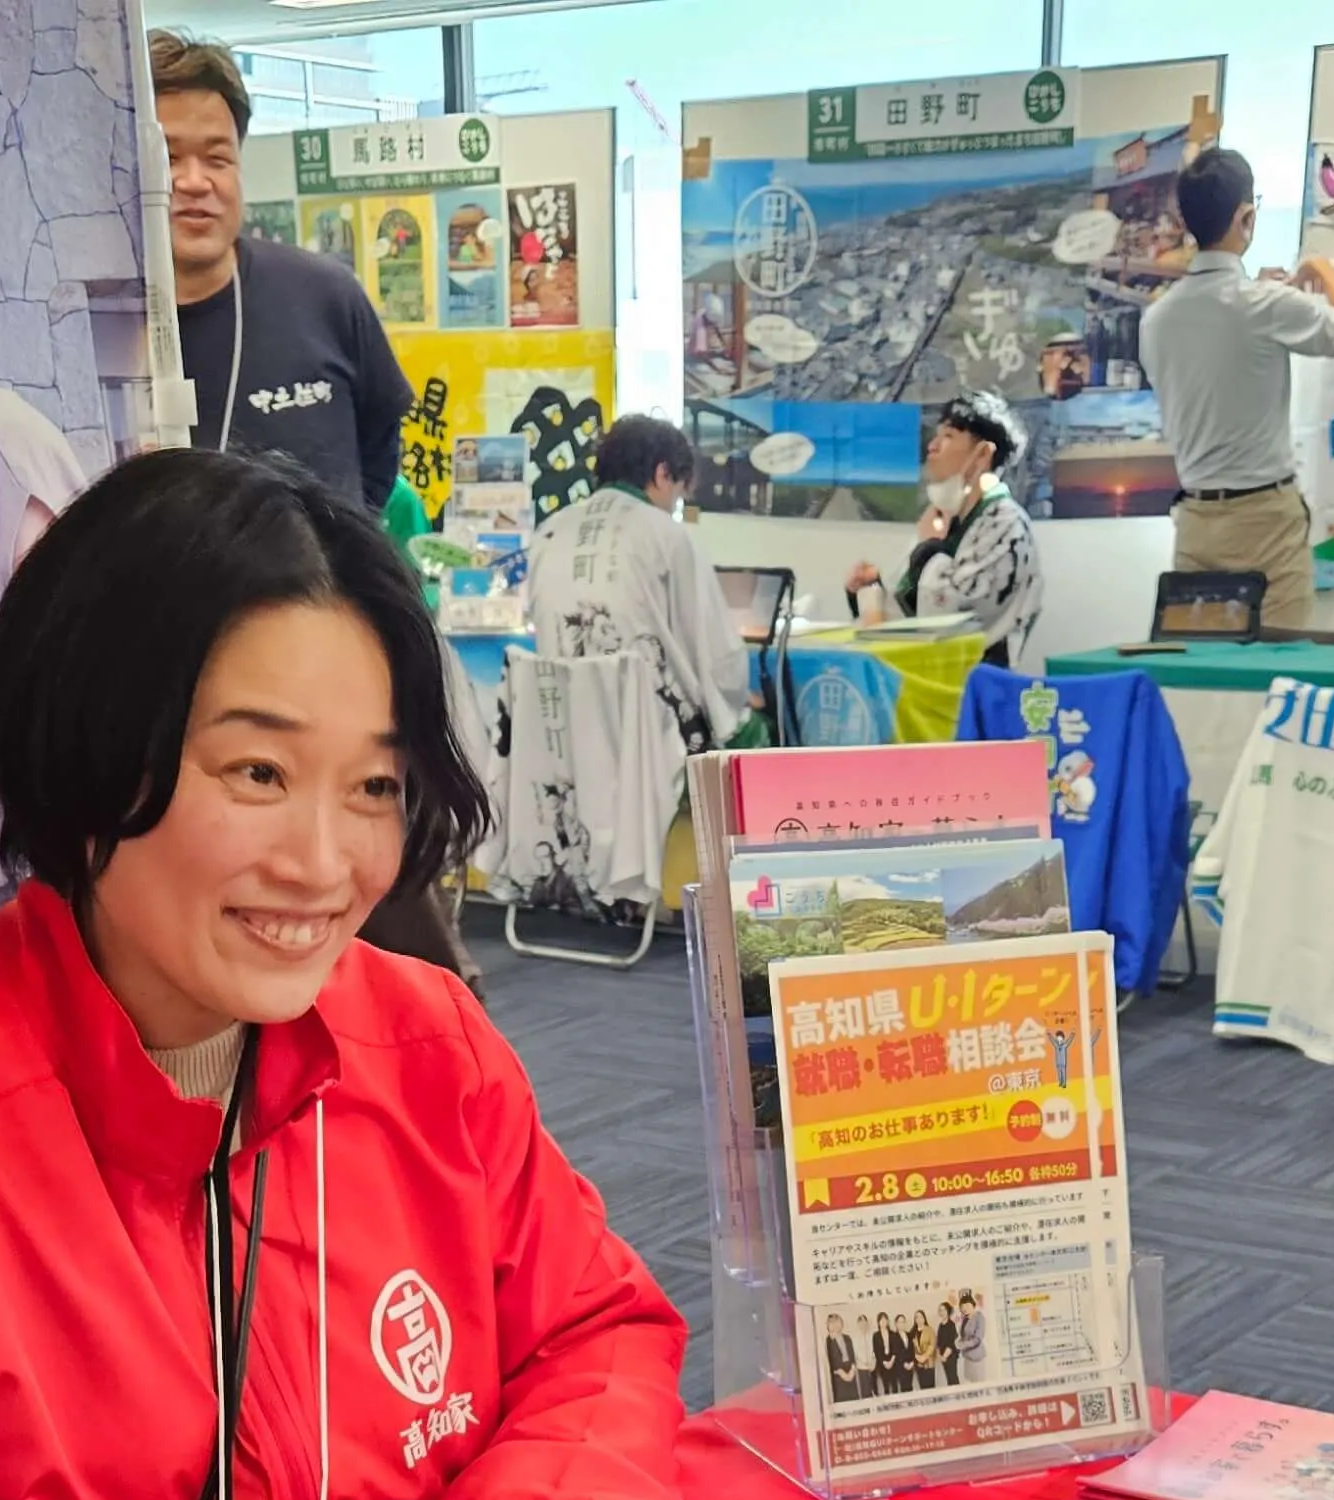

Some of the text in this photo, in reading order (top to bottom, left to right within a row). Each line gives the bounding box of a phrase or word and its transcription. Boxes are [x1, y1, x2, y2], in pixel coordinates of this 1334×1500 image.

[819, 96, 843, 123] 31
[887, 93, 981, 126] 田野町
[300, 137, 322, 162] 30
[353, 133, 425, 166] 馬路村
[792, 1016, 1048, 1099] 就職・転職相談会
[399, 1391, 481, 1469] 高知家
